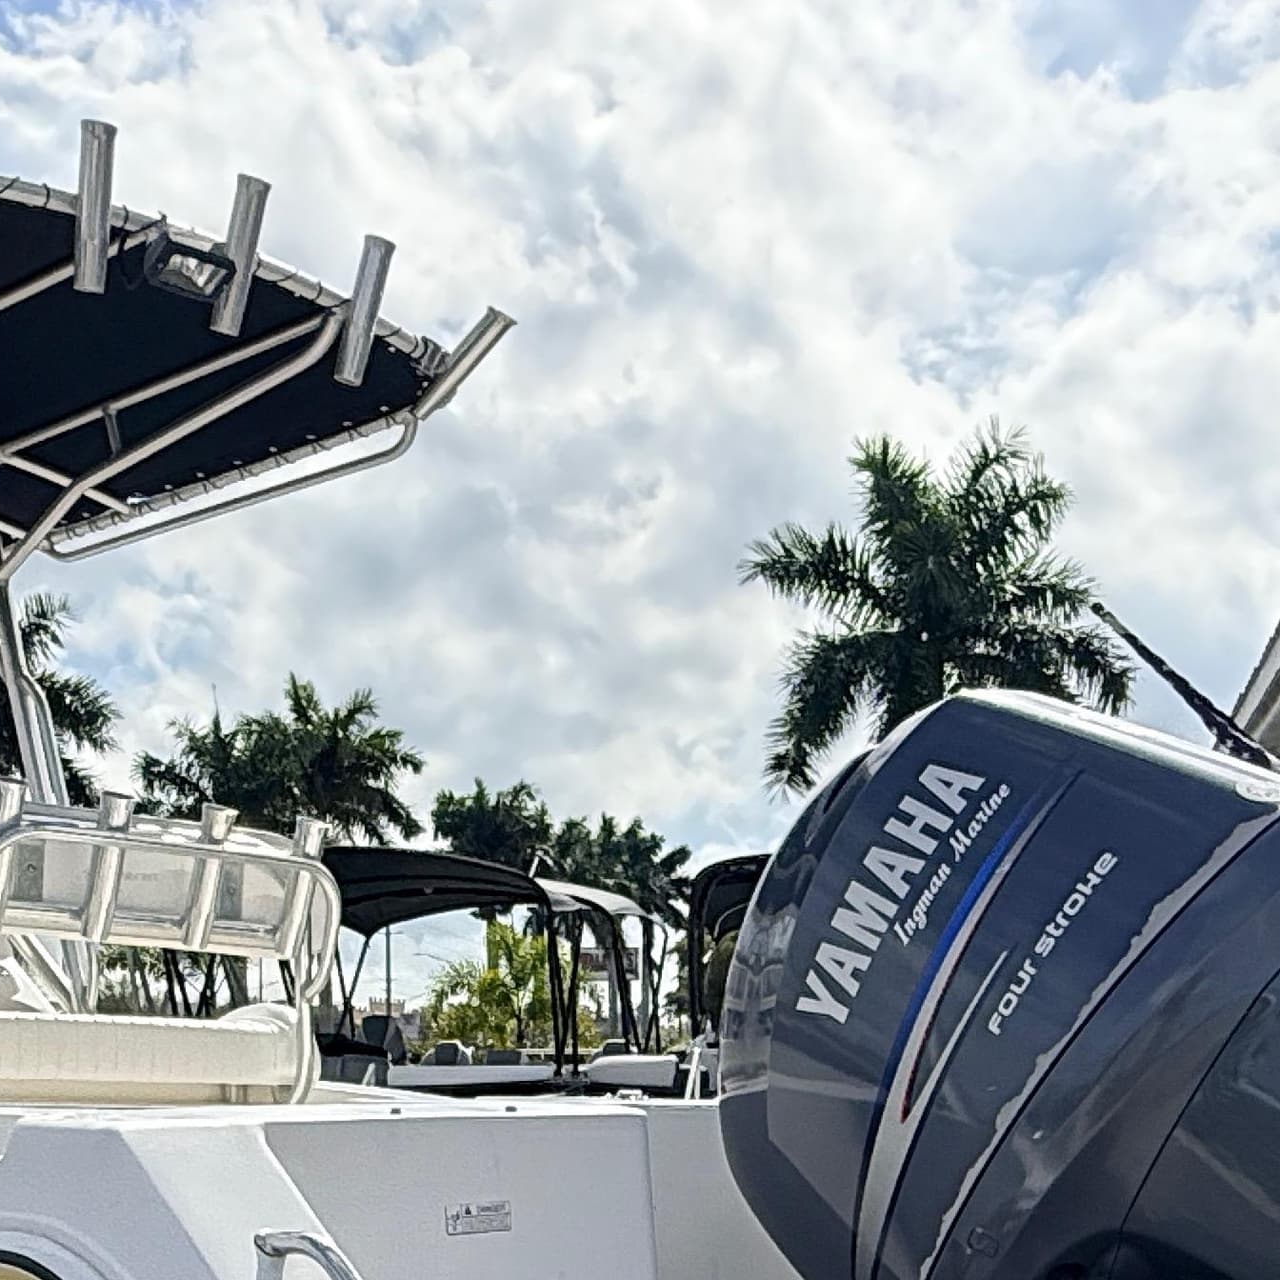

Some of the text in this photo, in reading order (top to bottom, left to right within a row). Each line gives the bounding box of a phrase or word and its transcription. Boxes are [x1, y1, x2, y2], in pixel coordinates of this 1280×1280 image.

[795, 763, 987, 1025] YAMAHA
[892, 783, 1012, 947] Ingman Marine
